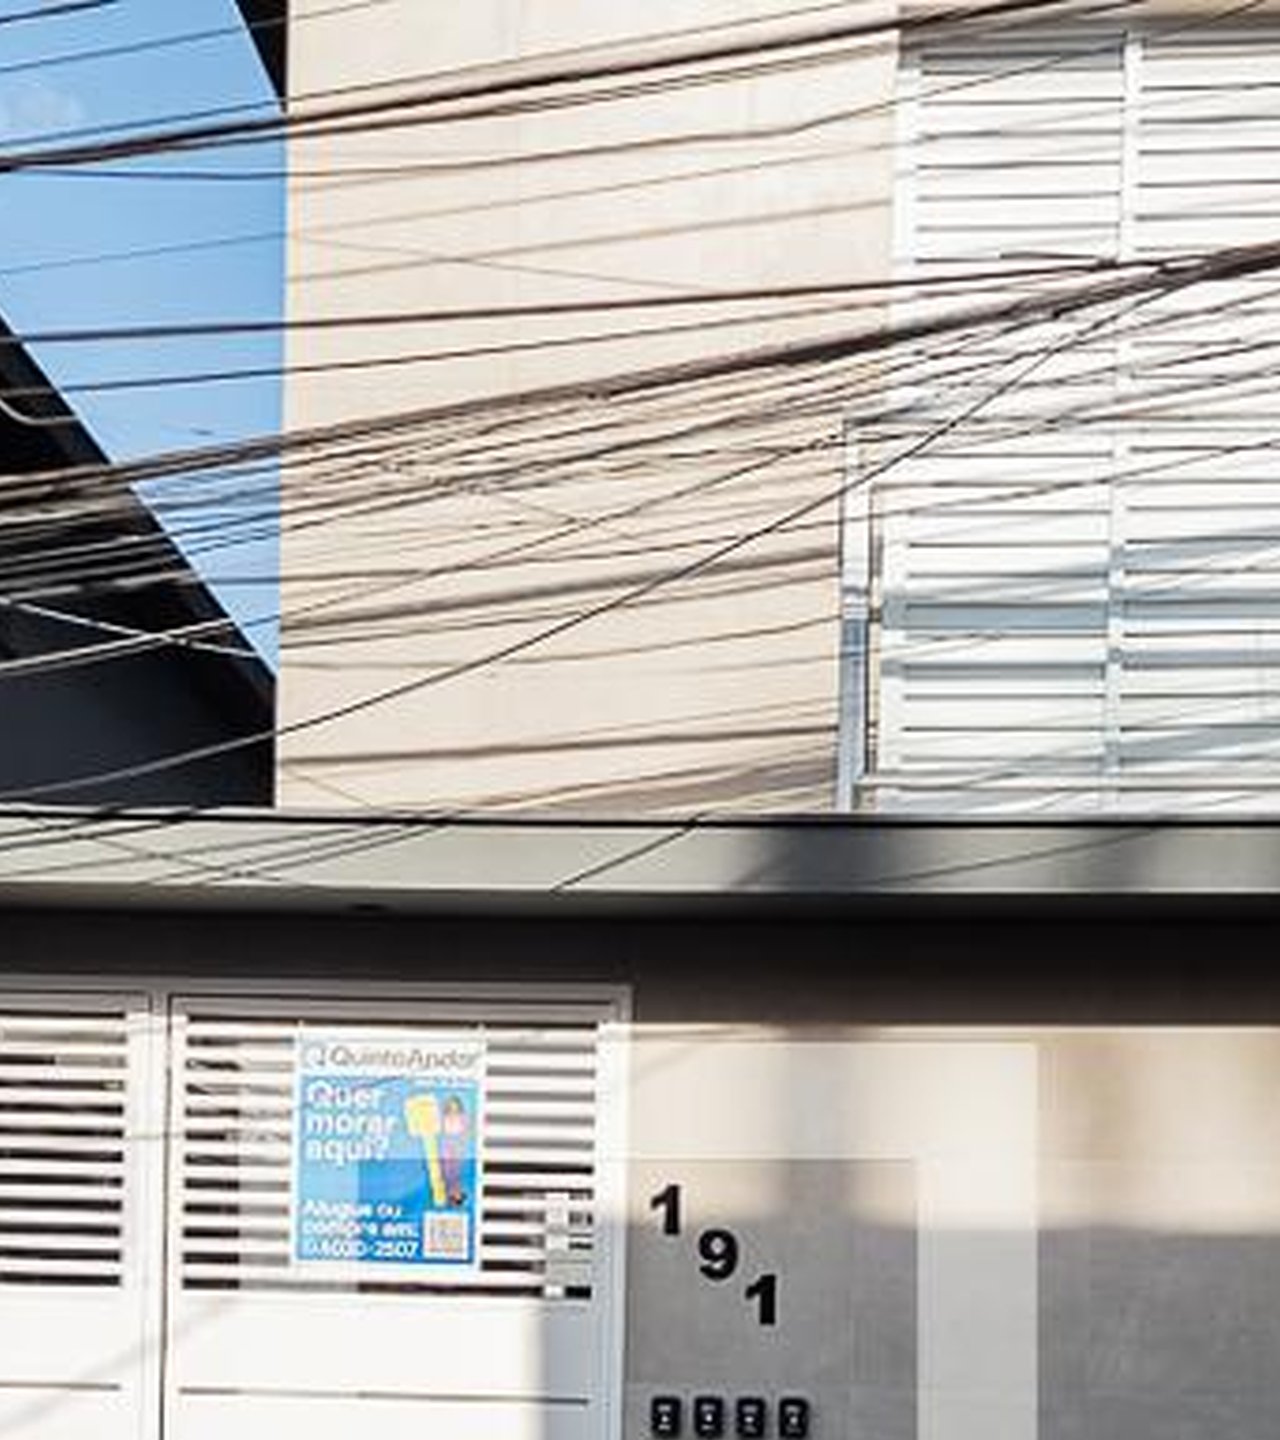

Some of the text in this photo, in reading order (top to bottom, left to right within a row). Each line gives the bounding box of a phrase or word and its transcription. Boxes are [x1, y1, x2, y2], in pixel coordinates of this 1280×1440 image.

[329, 1045, 477, 1069] QuintoAndar
[305, 1080, 382, 1109] Quer
[305, 1111, 401, 1134] morar
[650, 1184, 777, 1326] 191
